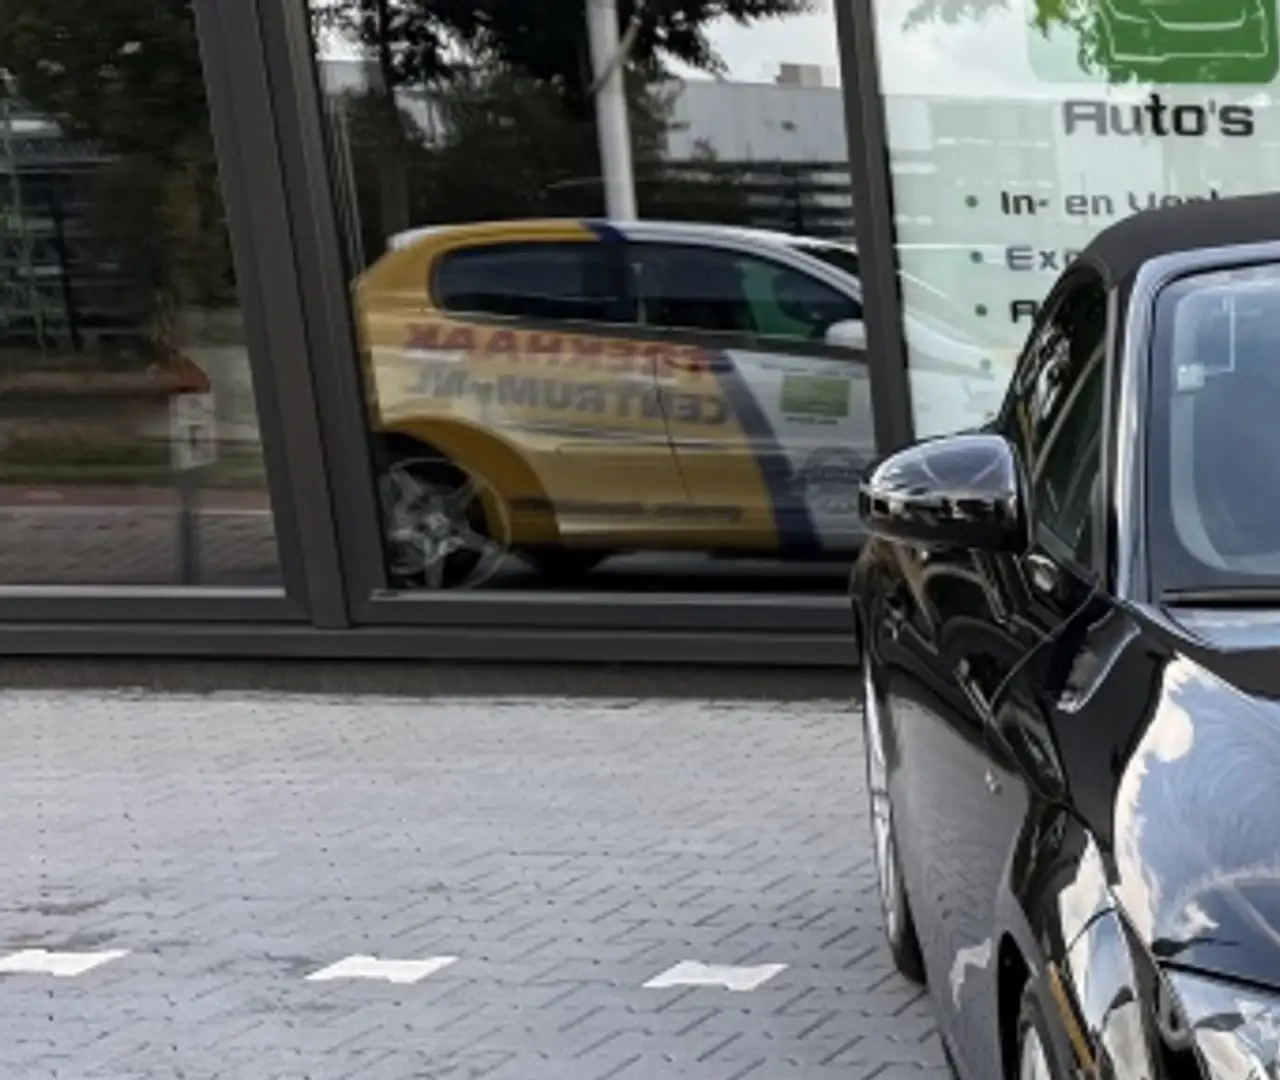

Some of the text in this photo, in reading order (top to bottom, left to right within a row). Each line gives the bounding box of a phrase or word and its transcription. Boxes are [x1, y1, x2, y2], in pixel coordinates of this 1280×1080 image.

[1062, 93, 1255, 137] Auto's
[1001, 190, 1050, 216] In-
[1064, 193, 1114, 216] en
